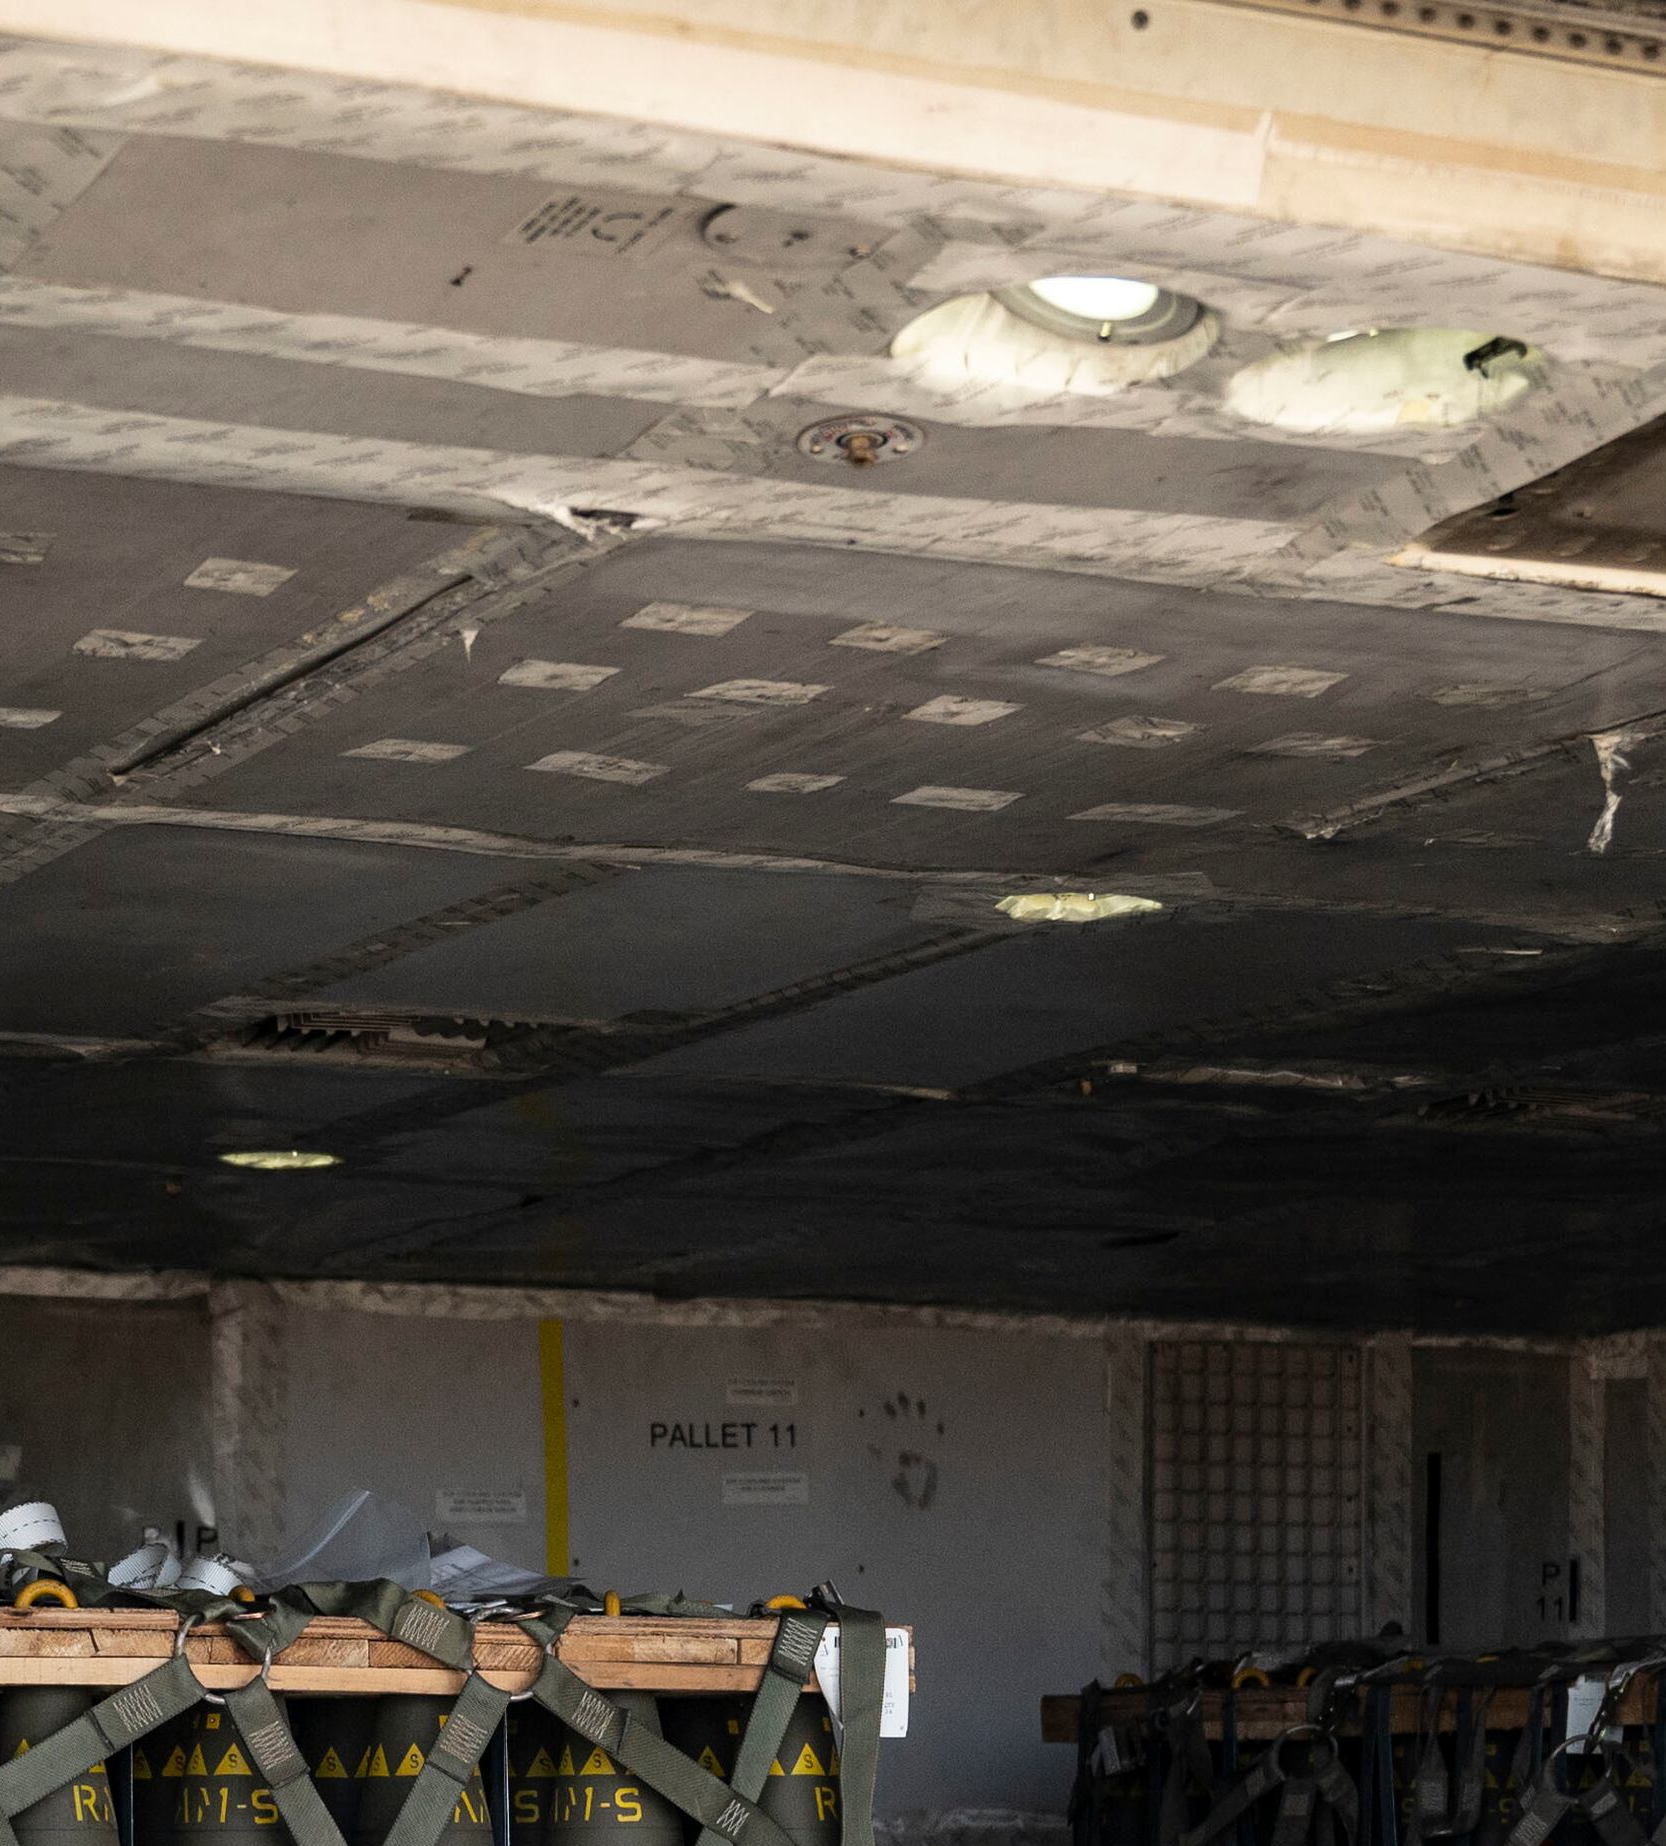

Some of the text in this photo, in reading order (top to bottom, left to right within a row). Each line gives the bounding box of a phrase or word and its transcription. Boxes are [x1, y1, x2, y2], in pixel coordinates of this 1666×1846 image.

[649, 1422, 796, 1449] PALLET 11
[1541, 1563, 1560, 1585] P
[1535, 1597, 1563, 1621] 11
